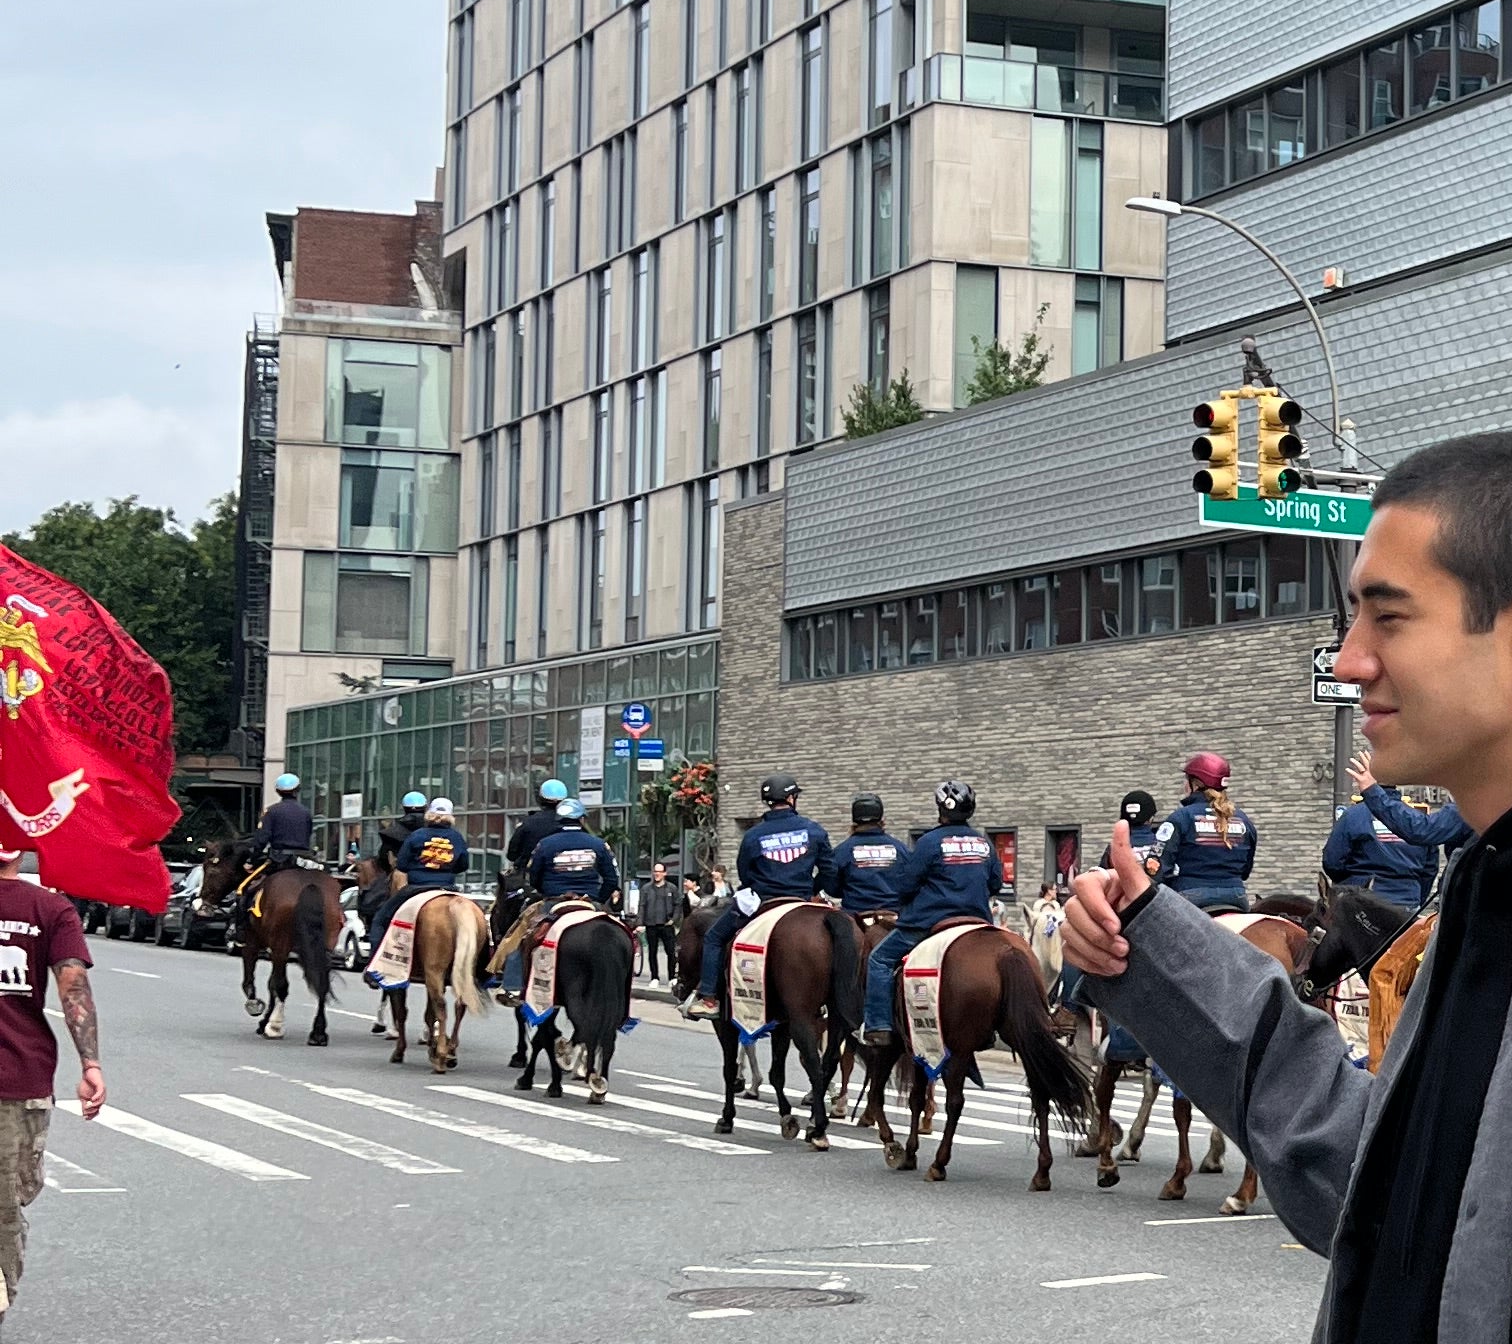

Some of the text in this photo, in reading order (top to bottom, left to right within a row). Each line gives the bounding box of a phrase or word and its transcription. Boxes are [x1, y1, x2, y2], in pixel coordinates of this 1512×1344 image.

[1264, 497, 1347, 527] Spring St
[1321, 684, 1342, 695] ONE
